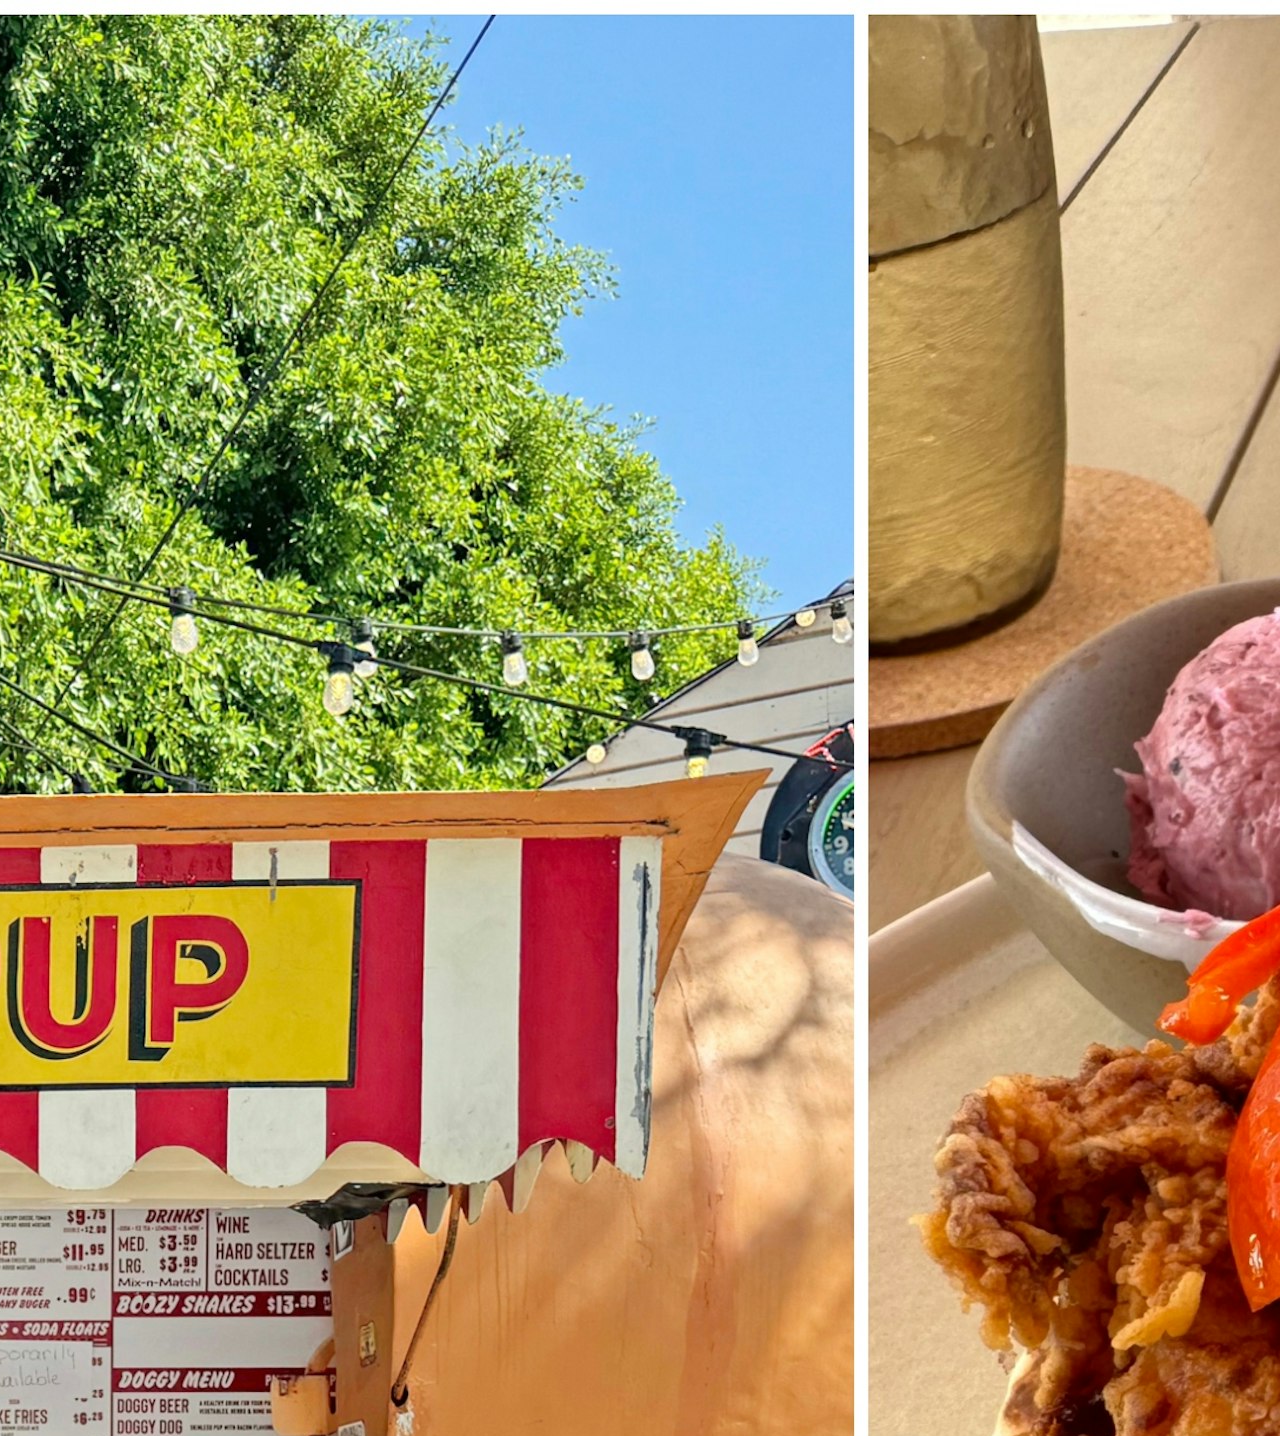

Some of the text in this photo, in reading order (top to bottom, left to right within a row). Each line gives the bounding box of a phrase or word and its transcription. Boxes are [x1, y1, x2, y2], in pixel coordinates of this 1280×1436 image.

[67, 1209, 106, 1225] $9.75
[146, 1209, 204, 1223] DRINKS
[216, 1217, 249, 1233] WINE
[118, 1235, 197, 1251] MED. $3.50
[63, 1244, 104, 1261] $11.95
[216, 1243, 314, 1260] HARD SELTZER
[119, 1259, 145, 1274] LRG.
[160, 1256, 197, 1272] $3.99
[215, 1269, 288, 1286] COCKTAILS
[21, 1287, 44, 1296] FREE
[0, 1300, 16, 1309] ANY
[116, 1294, 256, 1315] BOOZY SHAKES
[22, 1323, 58, 1336] SODA
[61, 1322, 109, 1336] FLOATS
[118, 1371, 235, 1389] DOGGY MENU
[117, 1399, 156, 1414] DOGGY
[159, 1399, 189, 1413] BEER
[14, 1409, 48, 1424] FRIES
[117, 1420, 156, 1435] DOGGY
[159, 1420, 183, 1434] DOG
